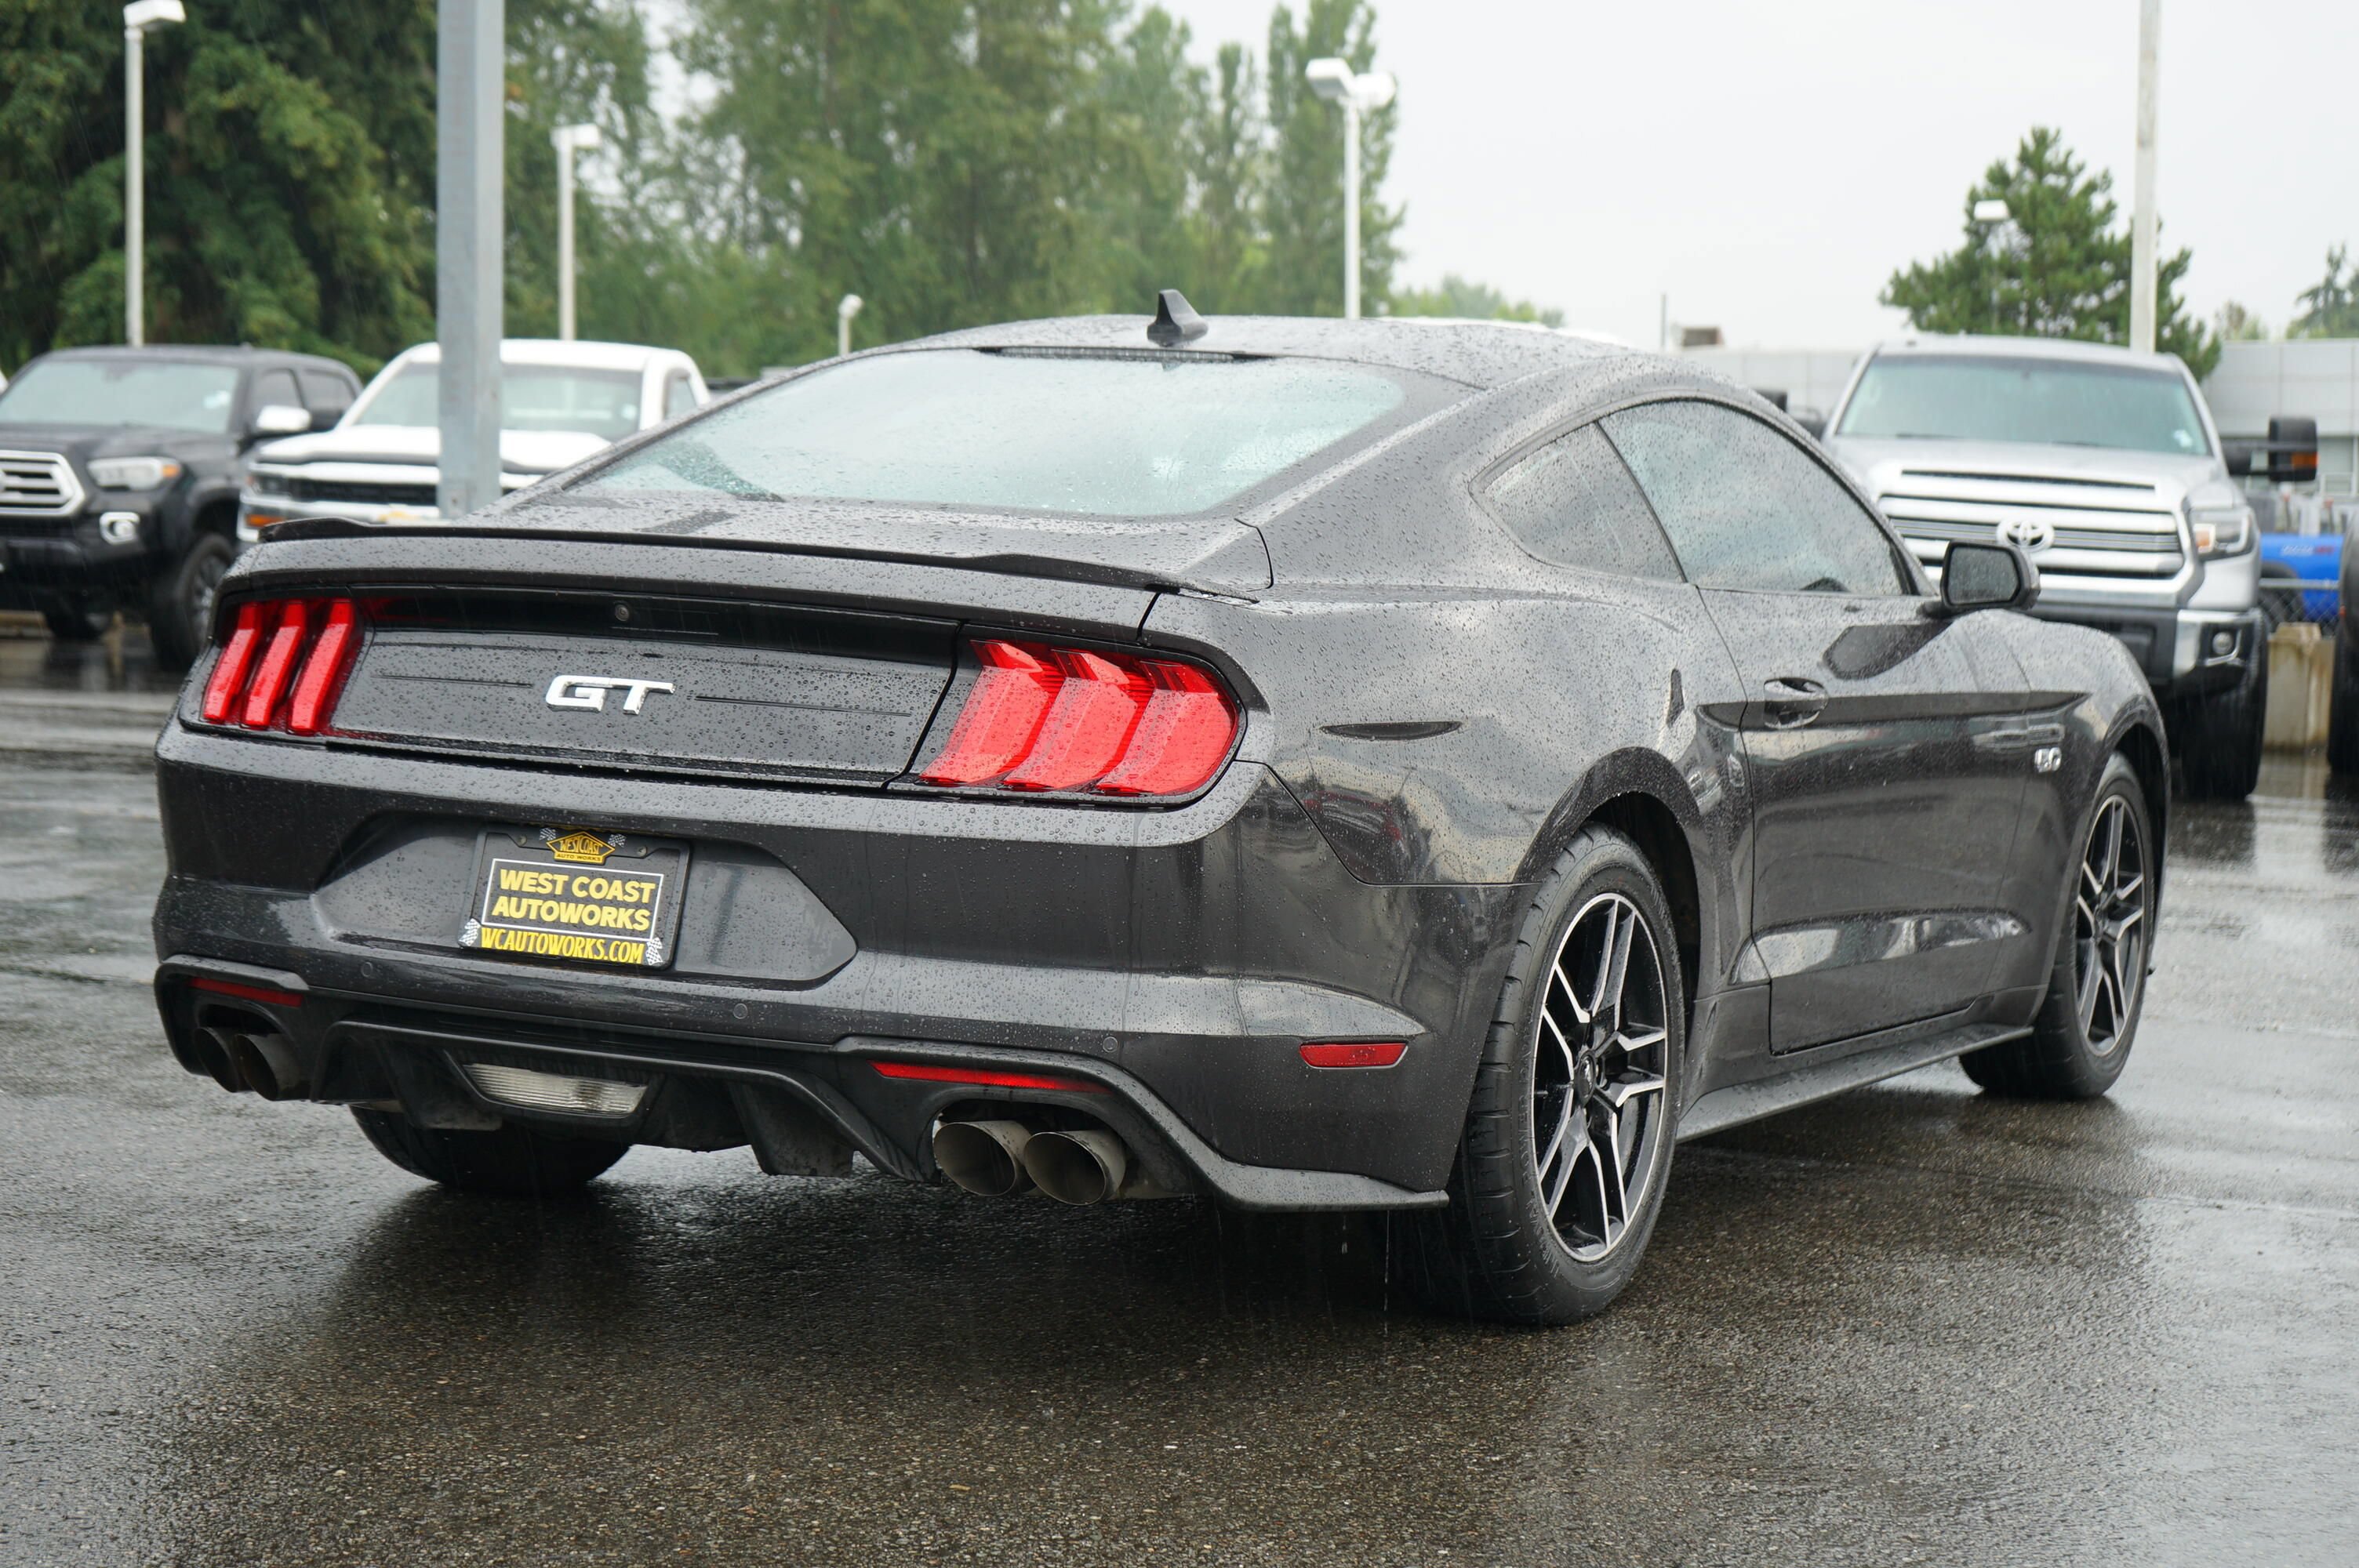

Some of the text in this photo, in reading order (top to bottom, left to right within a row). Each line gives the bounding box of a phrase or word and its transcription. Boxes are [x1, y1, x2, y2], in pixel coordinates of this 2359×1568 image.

[546, 675, 676, 715] GT
[500, 869, 656, 903] WEST COAST
[492, 896, 651, 931] AUTOWORKS
[481, 927, 645, 964] WCAUTOWORKS.COM
